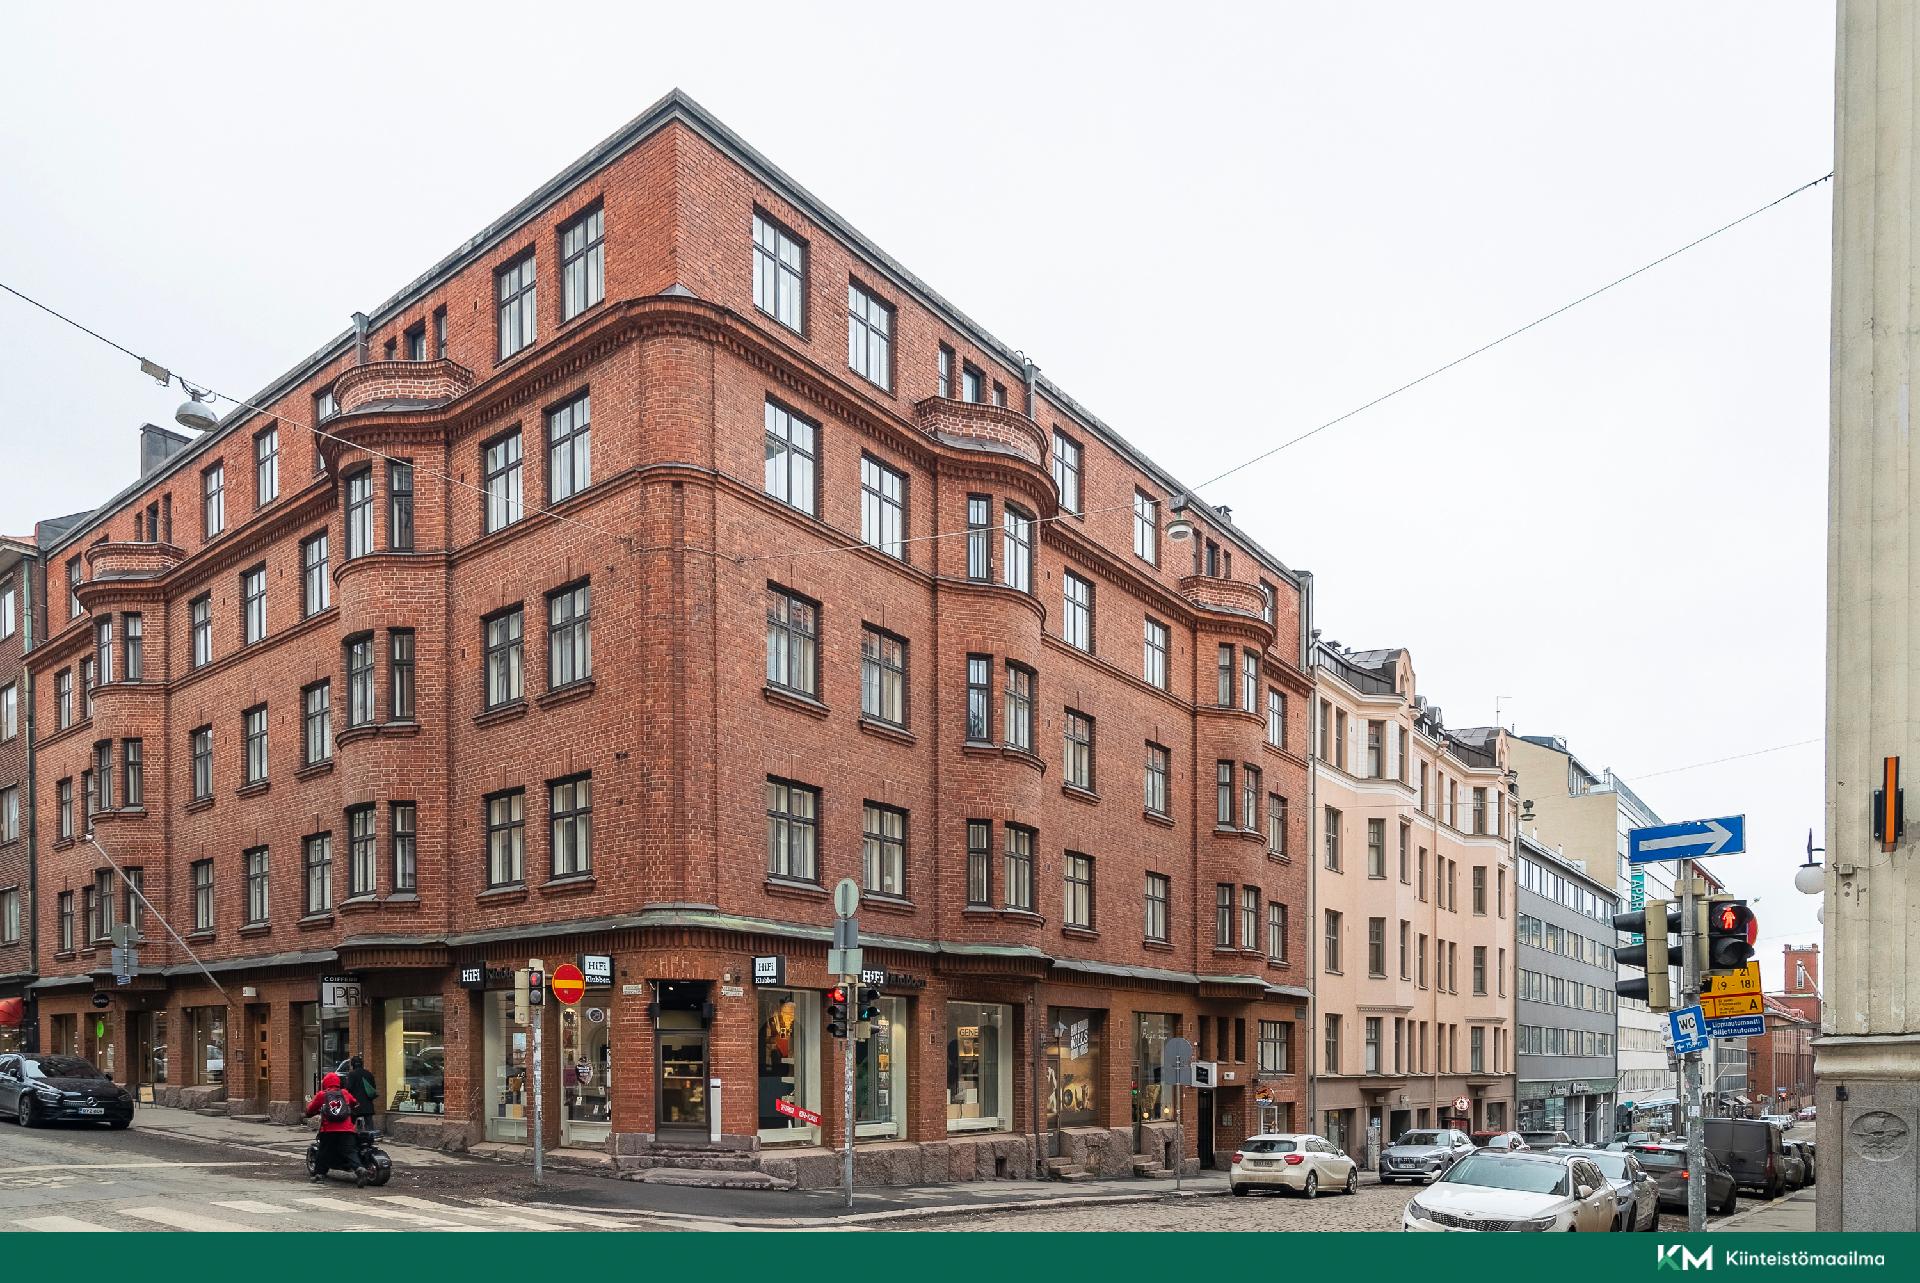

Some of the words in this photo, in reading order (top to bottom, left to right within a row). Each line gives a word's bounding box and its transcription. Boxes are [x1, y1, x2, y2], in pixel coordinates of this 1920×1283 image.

[587, 961, 607, 971] HiFi
[758, 962, 774, 971] HiFi
[462, 968, 481, 982] HiFi
[863, 970, 884, 984] HiFi
[1717, 981, 1727, 991] (9
[1740, 979, 1755, 989] 18)
[1749, 998, 1758, 1011] A
[1679, 1017, 1696, 1030] WC
